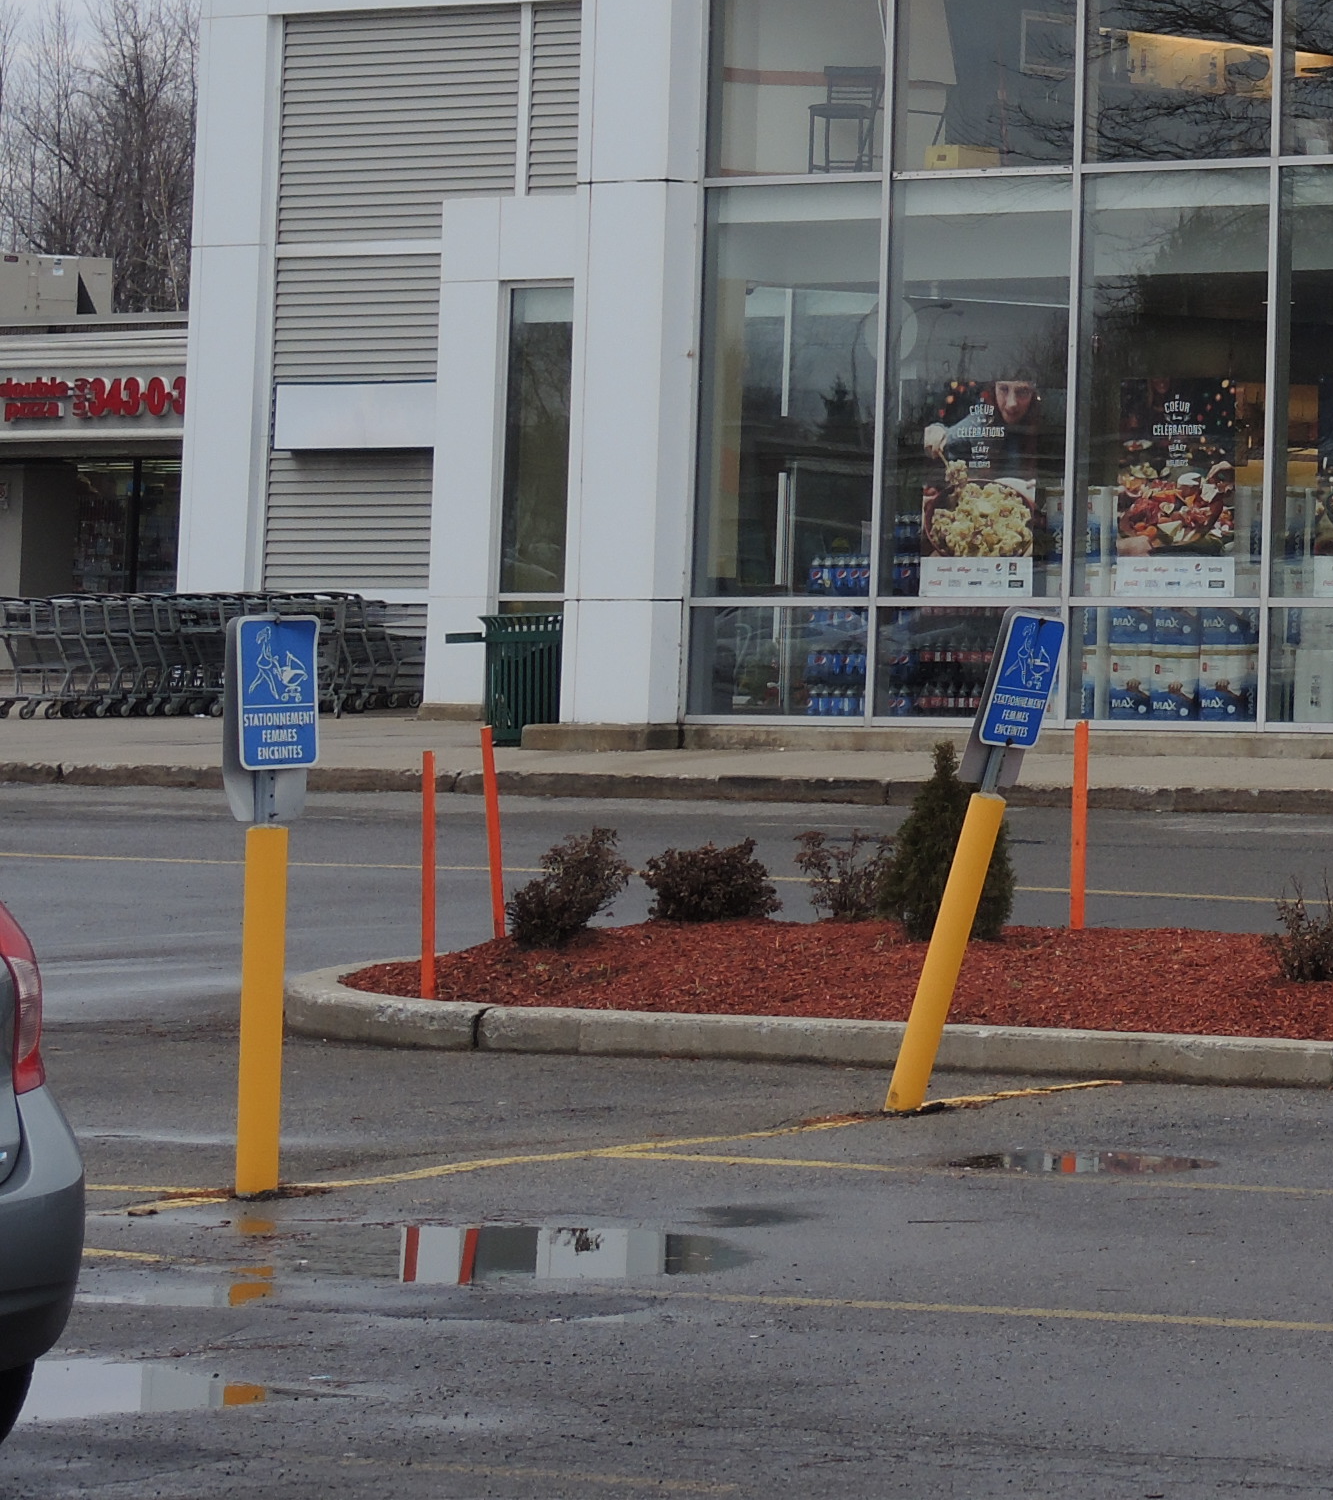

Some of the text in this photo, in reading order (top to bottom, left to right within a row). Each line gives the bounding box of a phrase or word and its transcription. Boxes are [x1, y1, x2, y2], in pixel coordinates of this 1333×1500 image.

[0, 377, 69, 398] double
[5, 402, 60, 422] pizza
[970, 404, 994, 416] COEUR
[1164, 401, 1190, 413] COEUR
[1113, 618, 1135, 626] MAX
[1156, 618, 1178, 628] MAX
[1203, 618, 1225, 628] MAX
[993, 694, 1045, 710] STATIONNEMENT
[1112, 698, 1134, 708] MAX
[1153, 700, 1176, 710] MAX
[1202, 698, 1224, 708] MAX
[244, 712, 314, 726] STATIONNEMENT
[1002, 710, 1030, 722] FEMMES
[262, 729, 298, 742] FEMMES
[994, 724, 1028, 738] ENCEINTES
[258, 746, 302, 760] ENCEINTES
